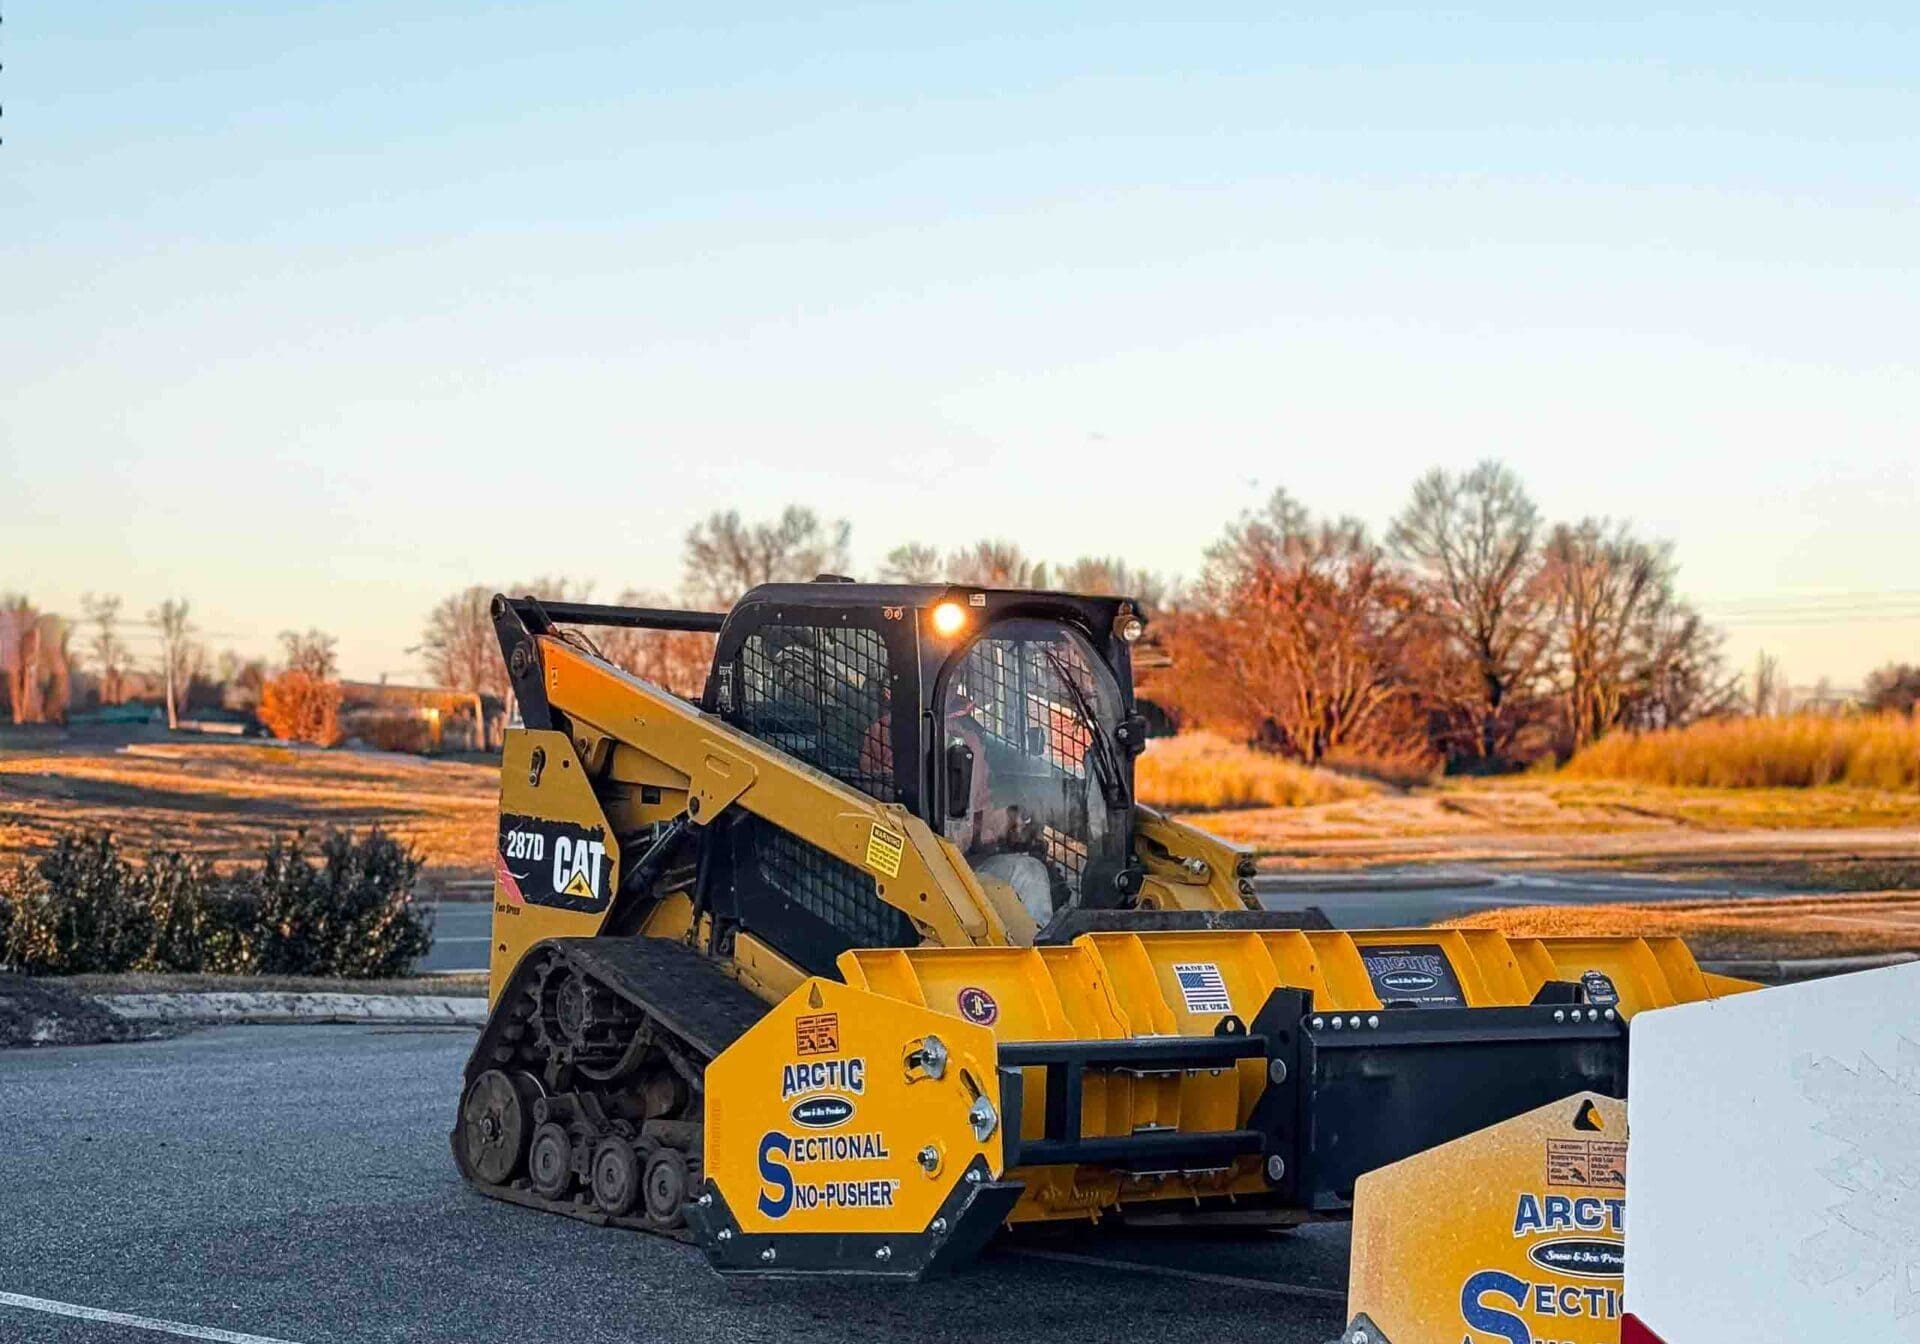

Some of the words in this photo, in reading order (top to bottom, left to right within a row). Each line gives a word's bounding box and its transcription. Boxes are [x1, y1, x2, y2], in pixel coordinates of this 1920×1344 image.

[506, 830, 545, 861] 287D
[553, 836, 606, 899] CAT
[782, 1058, 865, 1101] ARCTIC
[1545, 1249, 1572, 1261] Snow
[1573, 1251, 1581, 1262] &
[1582, 1251, 1599, 1262] Ice
